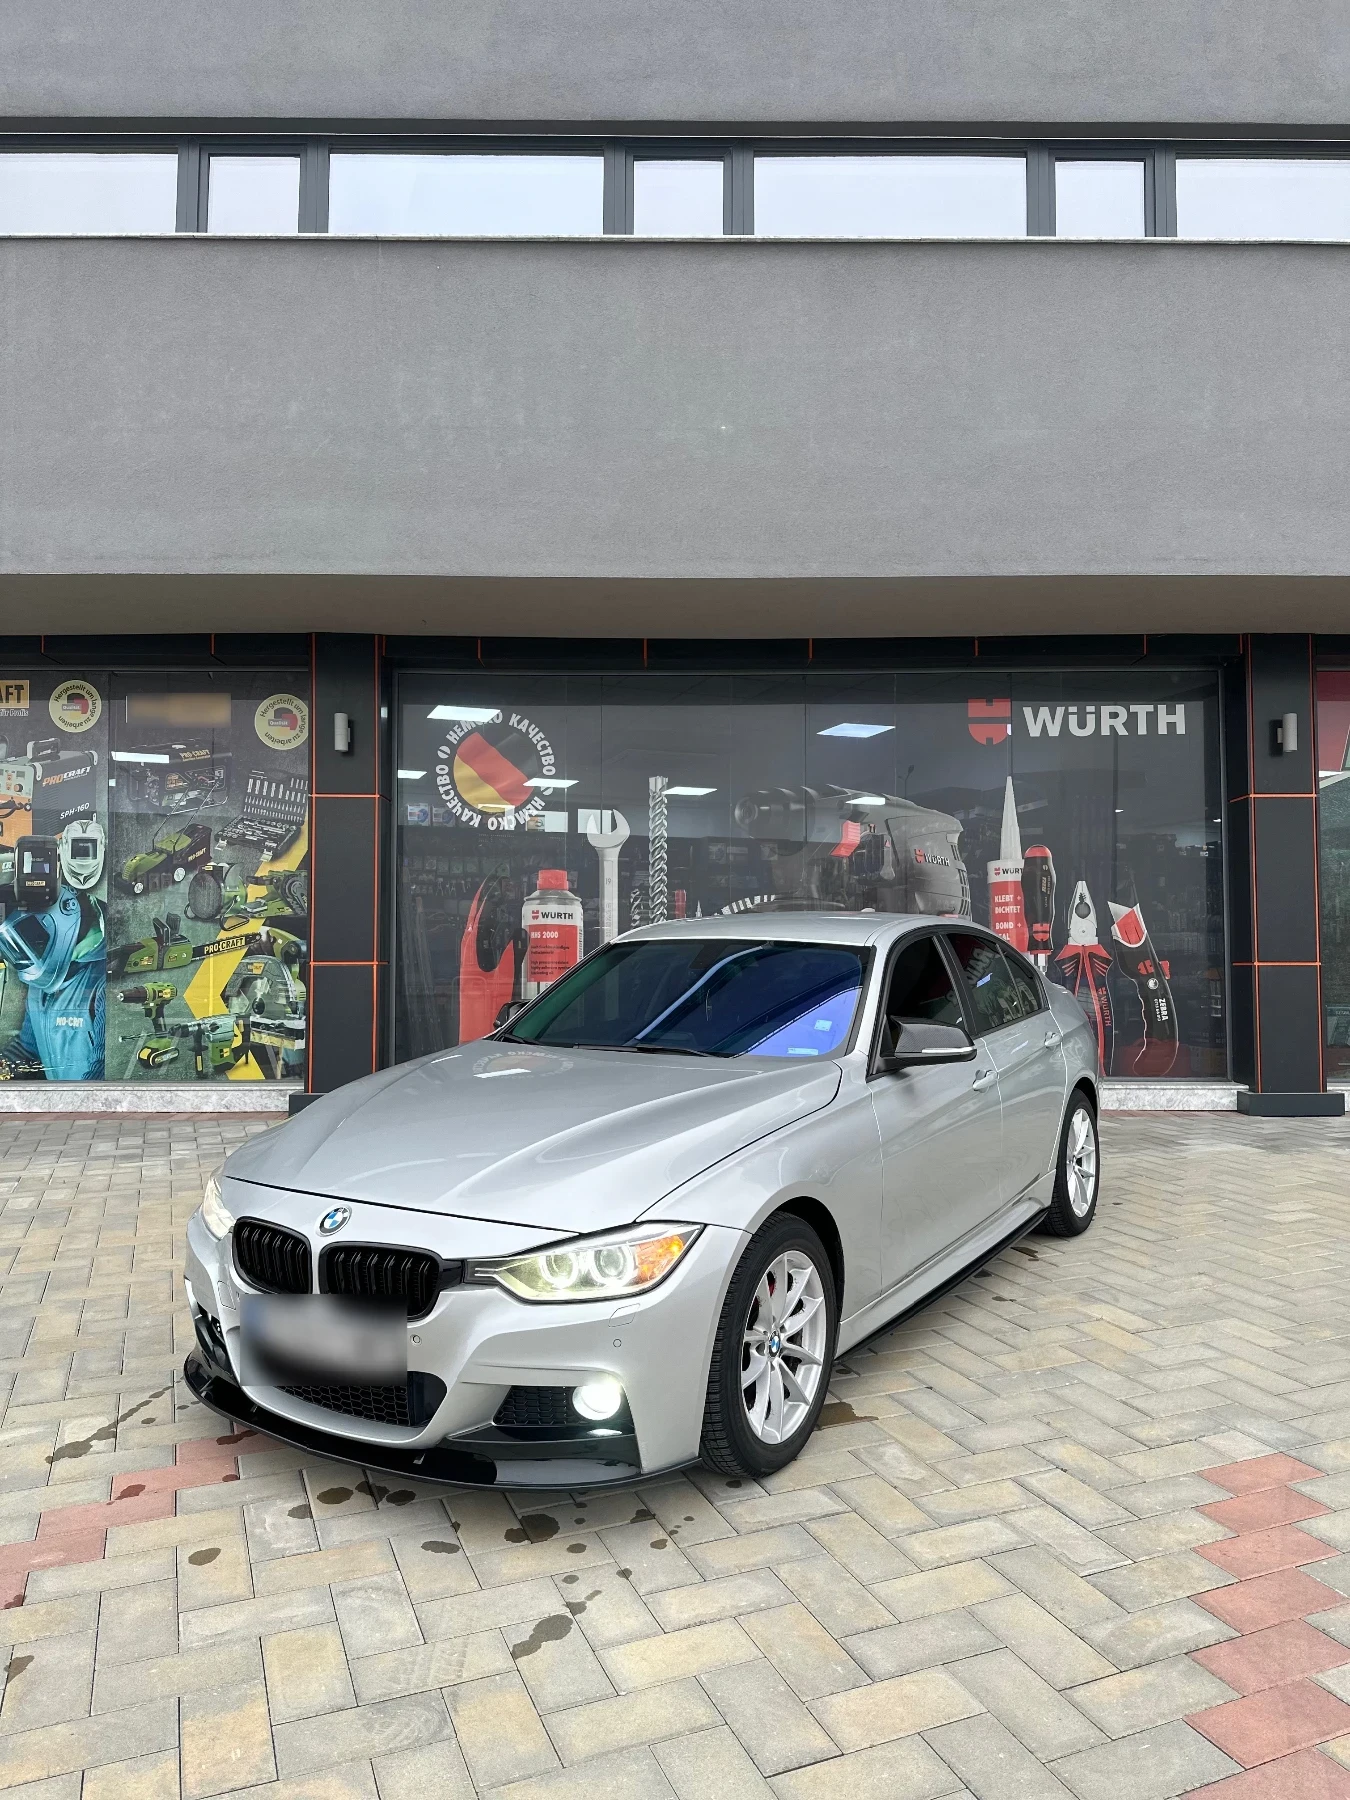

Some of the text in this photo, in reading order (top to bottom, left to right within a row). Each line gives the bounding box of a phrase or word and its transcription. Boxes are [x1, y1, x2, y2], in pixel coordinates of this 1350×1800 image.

[508, 713, 556, 776] КАЧЕСТВО
[435, 764, 482, 828] КАЧЕСТВО
[60, 802, 90, 820] SPH-160
[487, 796, 546, 831] НЕМСКО
[994, 894, 1014, 902] KLEBT
[994, 906, 1021, 914] DICHTET
[542, 931, 559, 939] 2000
[995, 922, 1014, 930] BOND
[1158, 998, 1169, 1021] ZEBRA
